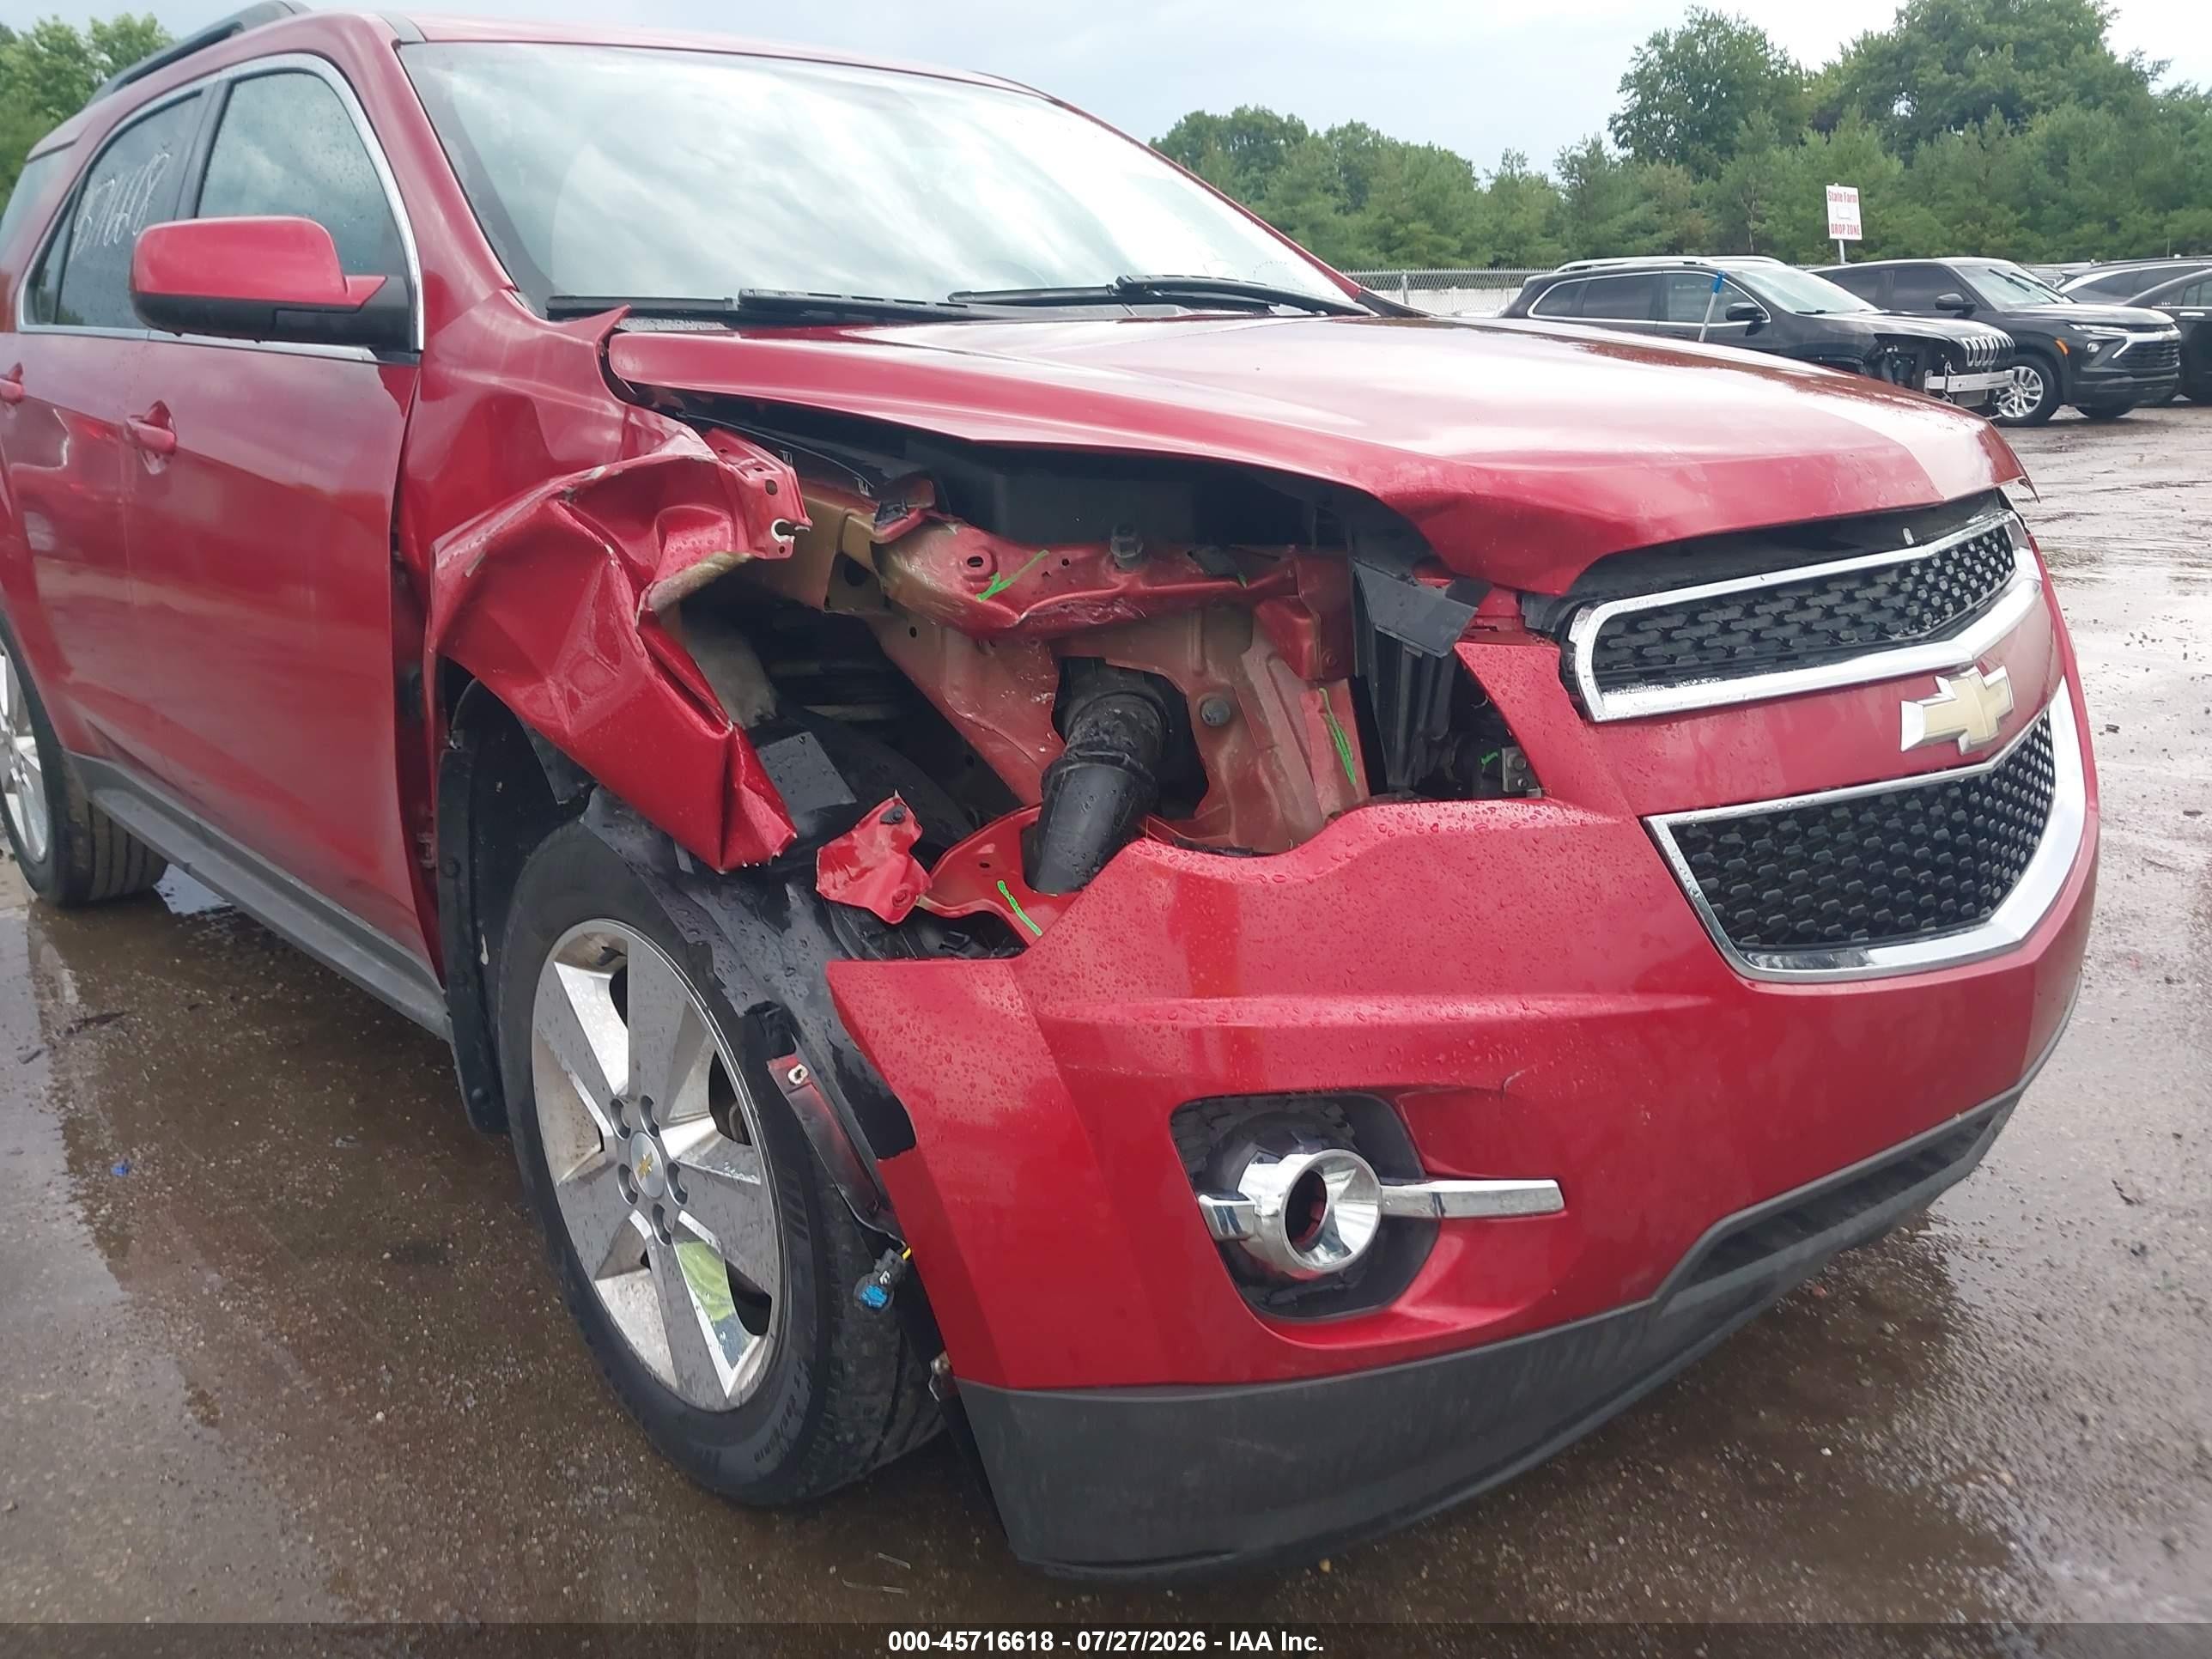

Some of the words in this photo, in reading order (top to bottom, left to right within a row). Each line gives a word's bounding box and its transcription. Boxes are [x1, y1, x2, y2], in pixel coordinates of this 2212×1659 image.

[1827, 190, 1843, 203] State
[1844, 191, 1857, 204] Farm
[1831, 222, 1845, 234] DROP
[1847, 224, 1860, 235] ZONE
